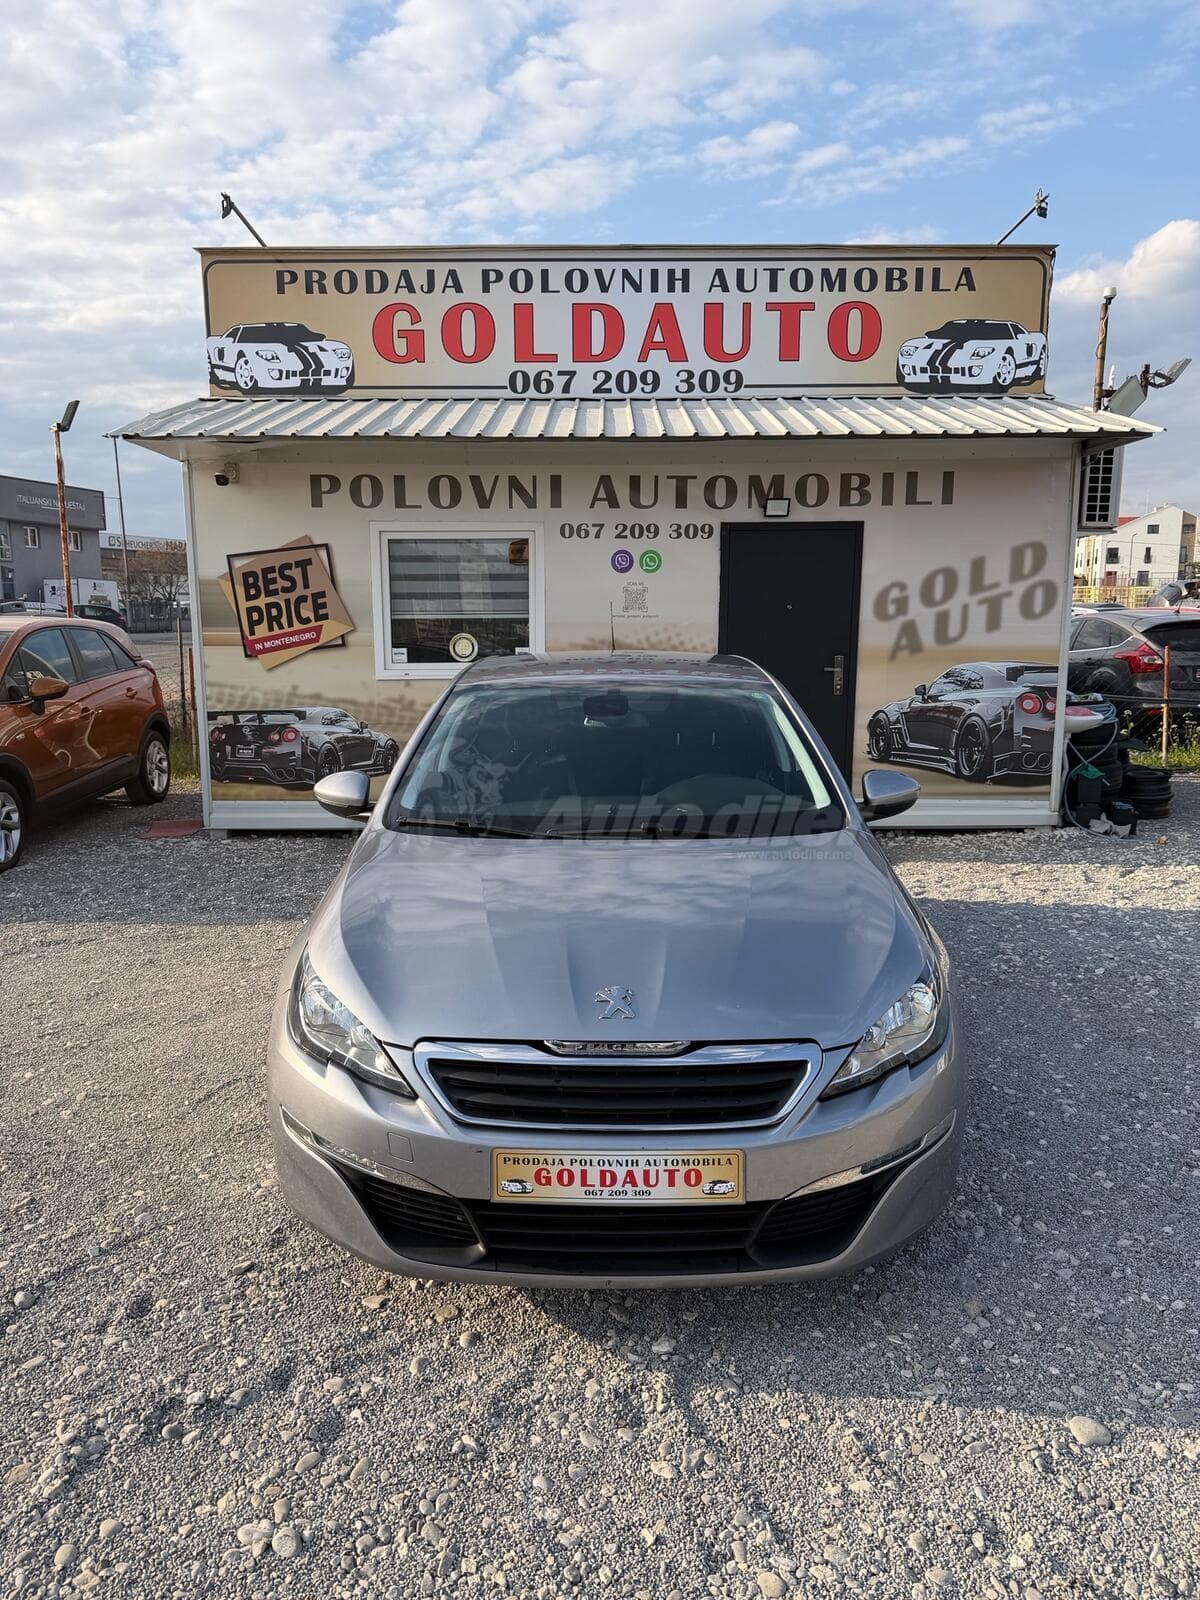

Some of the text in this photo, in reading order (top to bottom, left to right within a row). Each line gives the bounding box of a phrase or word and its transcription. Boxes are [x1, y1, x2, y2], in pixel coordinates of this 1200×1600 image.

[276, 266, 977, 295] PRODAJA POLOVNIH AUTOMOBILA
[371, 301, 883, 364] GOLDAUTO
[508, 368, 744, 395] 067 209 309
[309, 470, 956, 510] POLOVNI AUTOMOBILI
[559, 523, 714, 540] 067 209 309
[242, 558, 313, 602] BEST
[873, 540, 1048, 622] GOLD
[246, 591, 329, 637] PRICE
[887, 579, 1059, 663] AUTO
[264, 631, 317, 649] MONTENEGRO
[503, 1156, 733, 1168] PRODAJA POLOVNIH AUTOMOBILA
[533, 1167, 703, 1188] GOLDAUTO
[584, 1189, 651, 1197] 067 209 309
